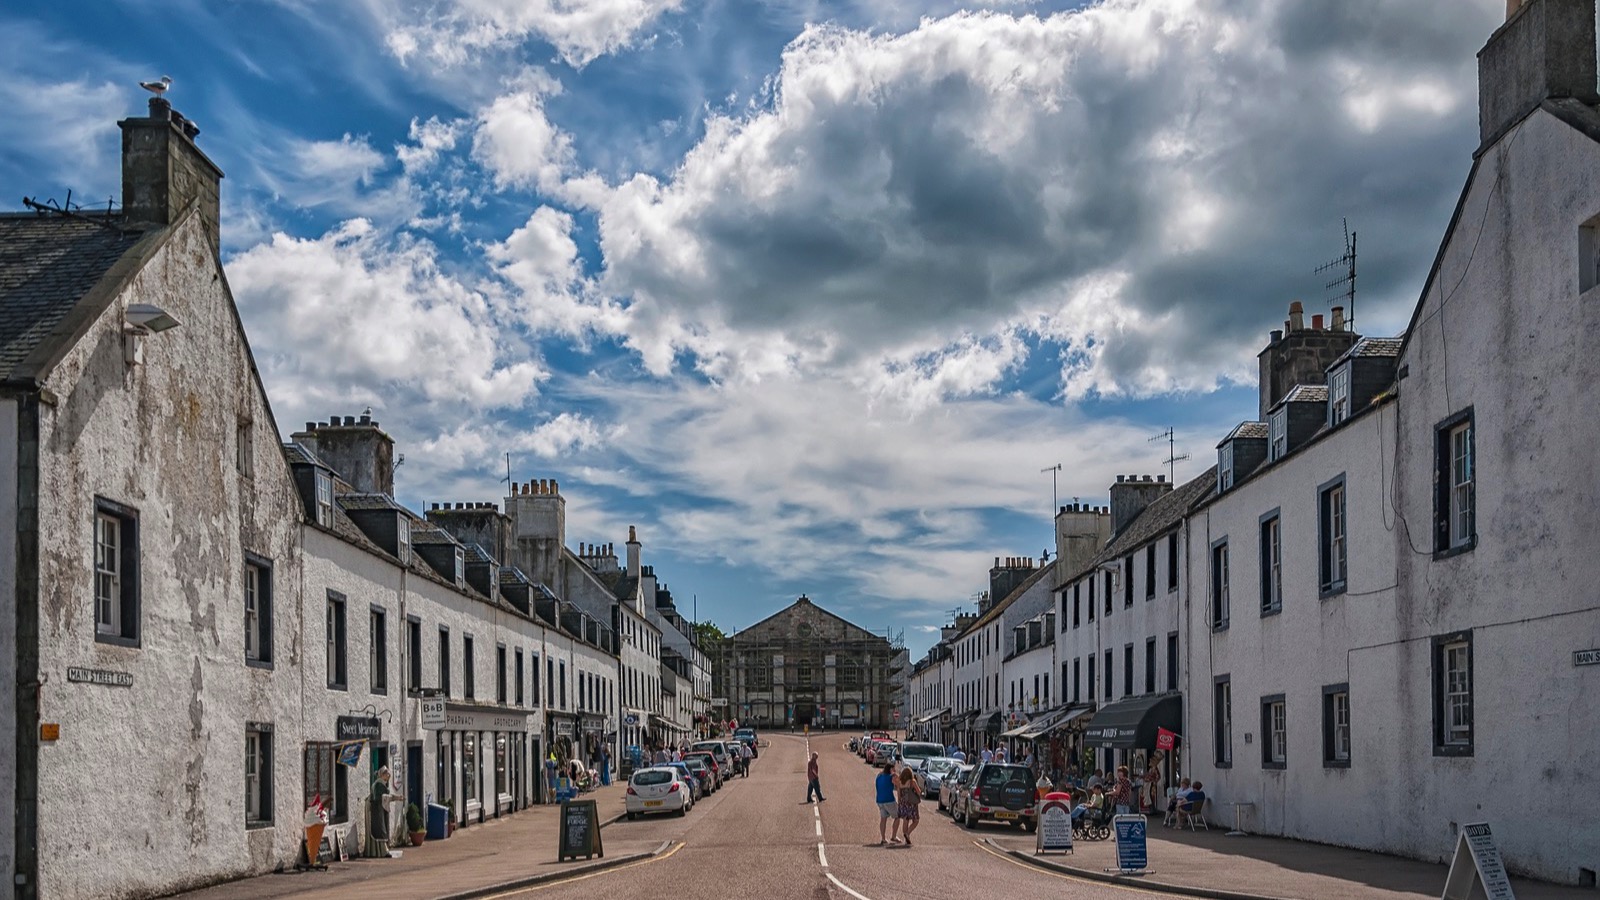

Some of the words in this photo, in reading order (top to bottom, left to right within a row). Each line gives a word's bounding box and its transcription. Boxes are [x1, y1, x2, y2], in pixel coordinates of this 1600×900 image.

[1576, 653, 1593, 663] MAIN
[70, 669, 89, 680] MAIN
[91, 671, 114, 683] STREET
[117, 674, 131, 685] EAST
[447, 715, 474, 725] PHARMACY
[494, 718, 521, 727] APOTHECARY
[342, 721, 357, 735] Sweet
[357, 722, 379, 735] Memories
[1465, 825, 1491, 836] DAVID'S
